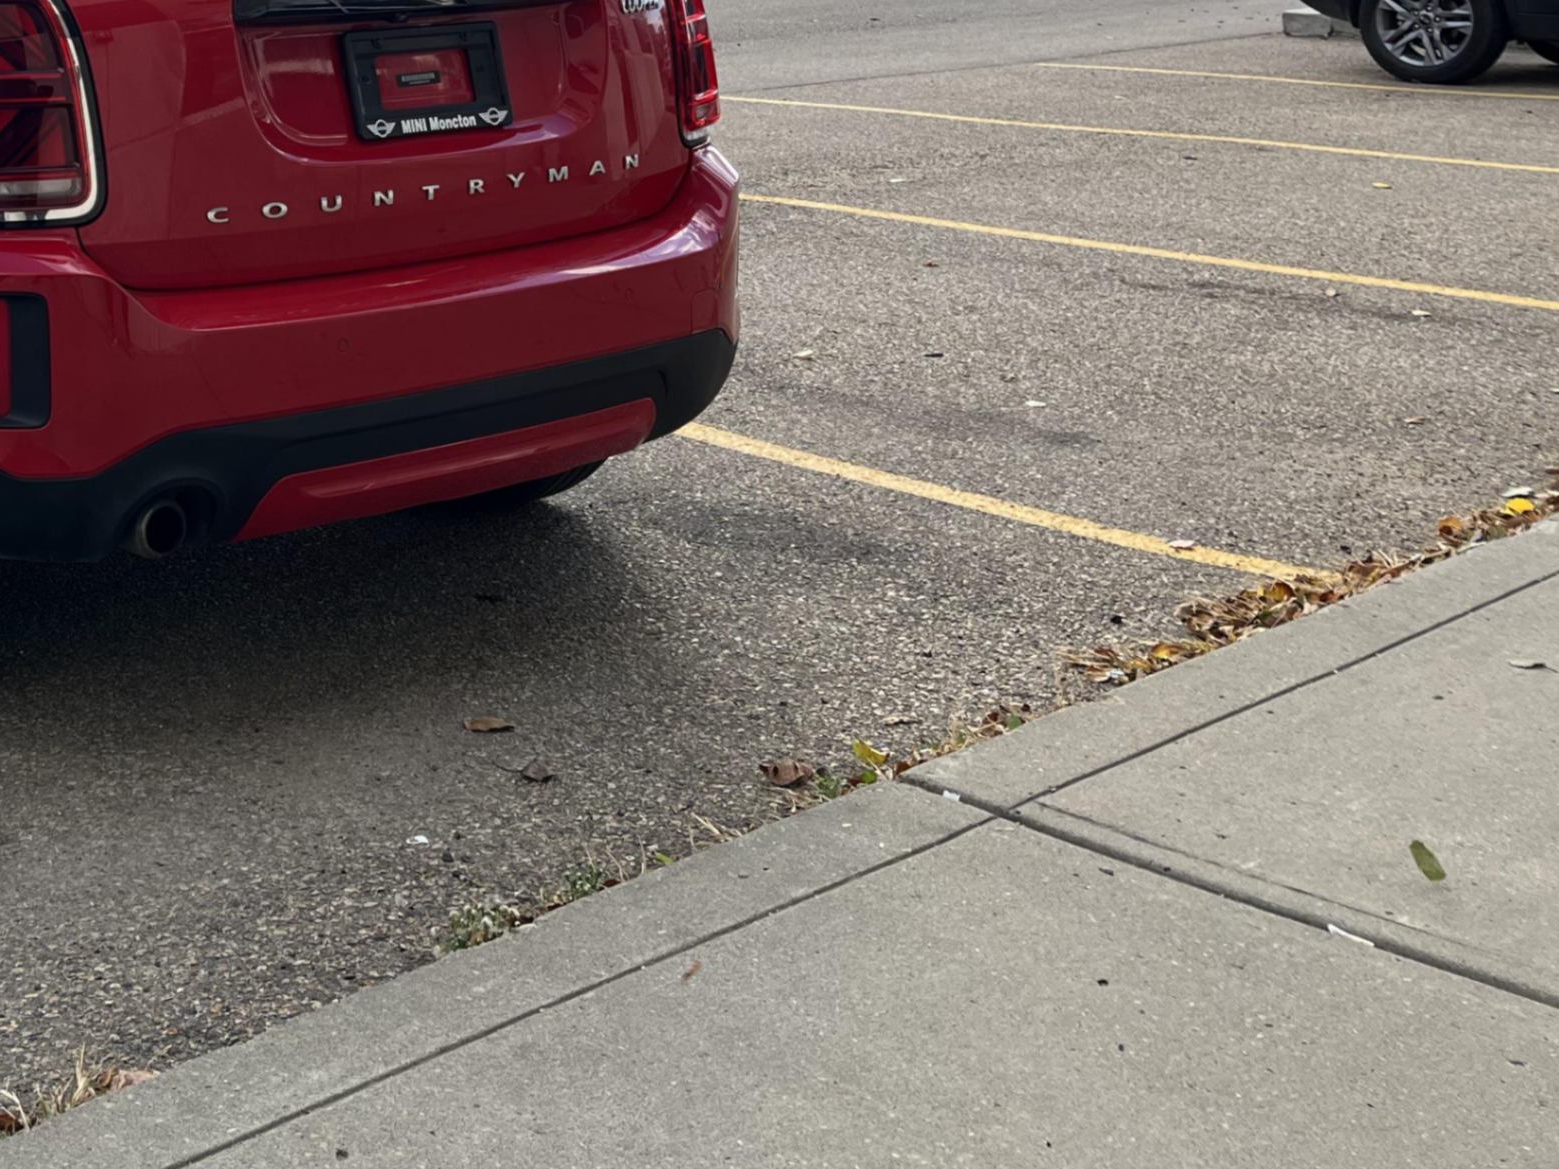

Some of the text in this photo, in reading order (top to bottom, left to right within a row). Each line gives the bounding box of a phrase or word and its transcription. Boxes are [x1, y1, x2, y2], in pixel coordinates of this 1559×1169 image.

[400, 114, 477, 134] MINI Moncton
[205, 153, 640, 224] COUNTRYMAN
